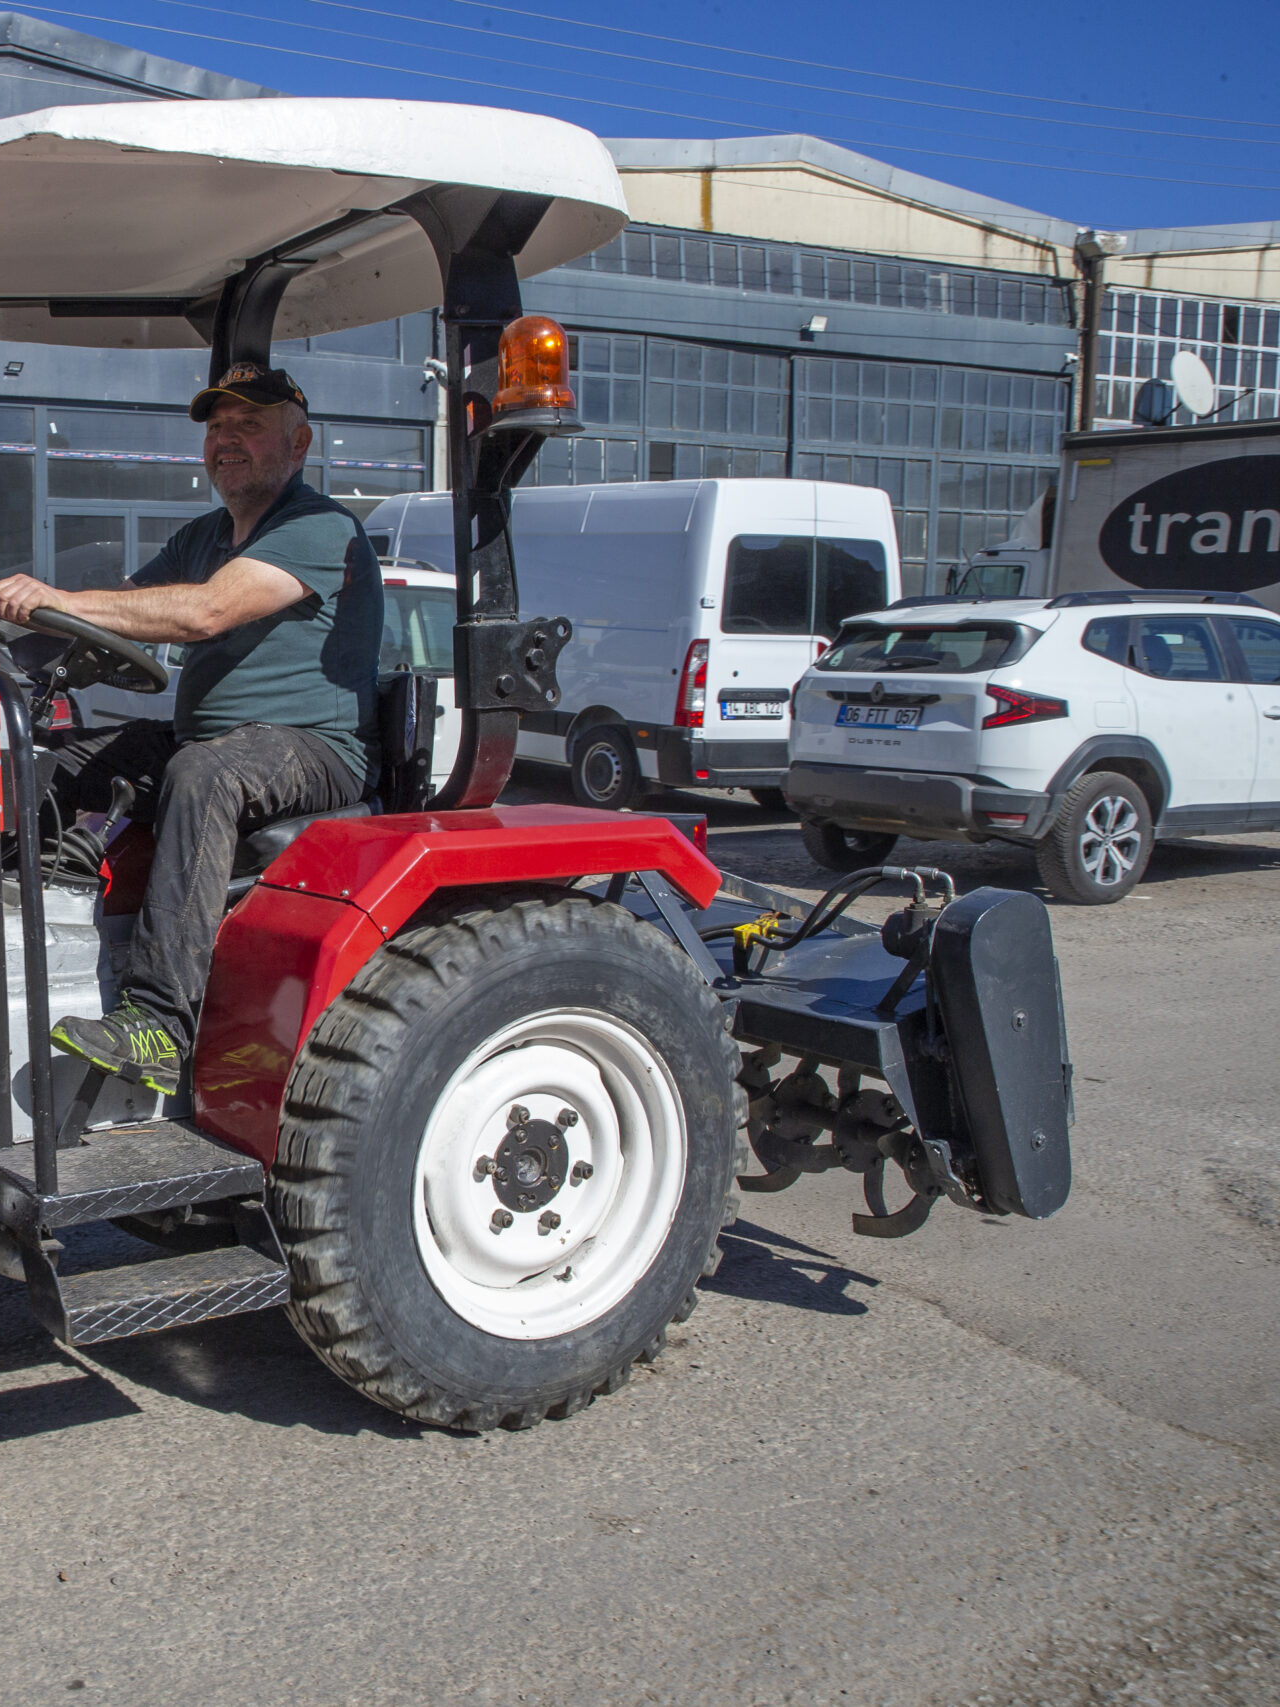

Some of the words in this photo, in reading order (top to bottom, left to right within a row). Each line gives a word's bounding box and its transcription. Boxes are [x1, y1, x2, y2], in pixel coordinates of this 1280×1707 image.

[728, 702, 739, 714] 14
[845, 706, 861, 722] 06
[864, 708, 889, 724] FTT
[894, 709, 918, 725] 057
[848, 737, 902, 746] DUSTER
